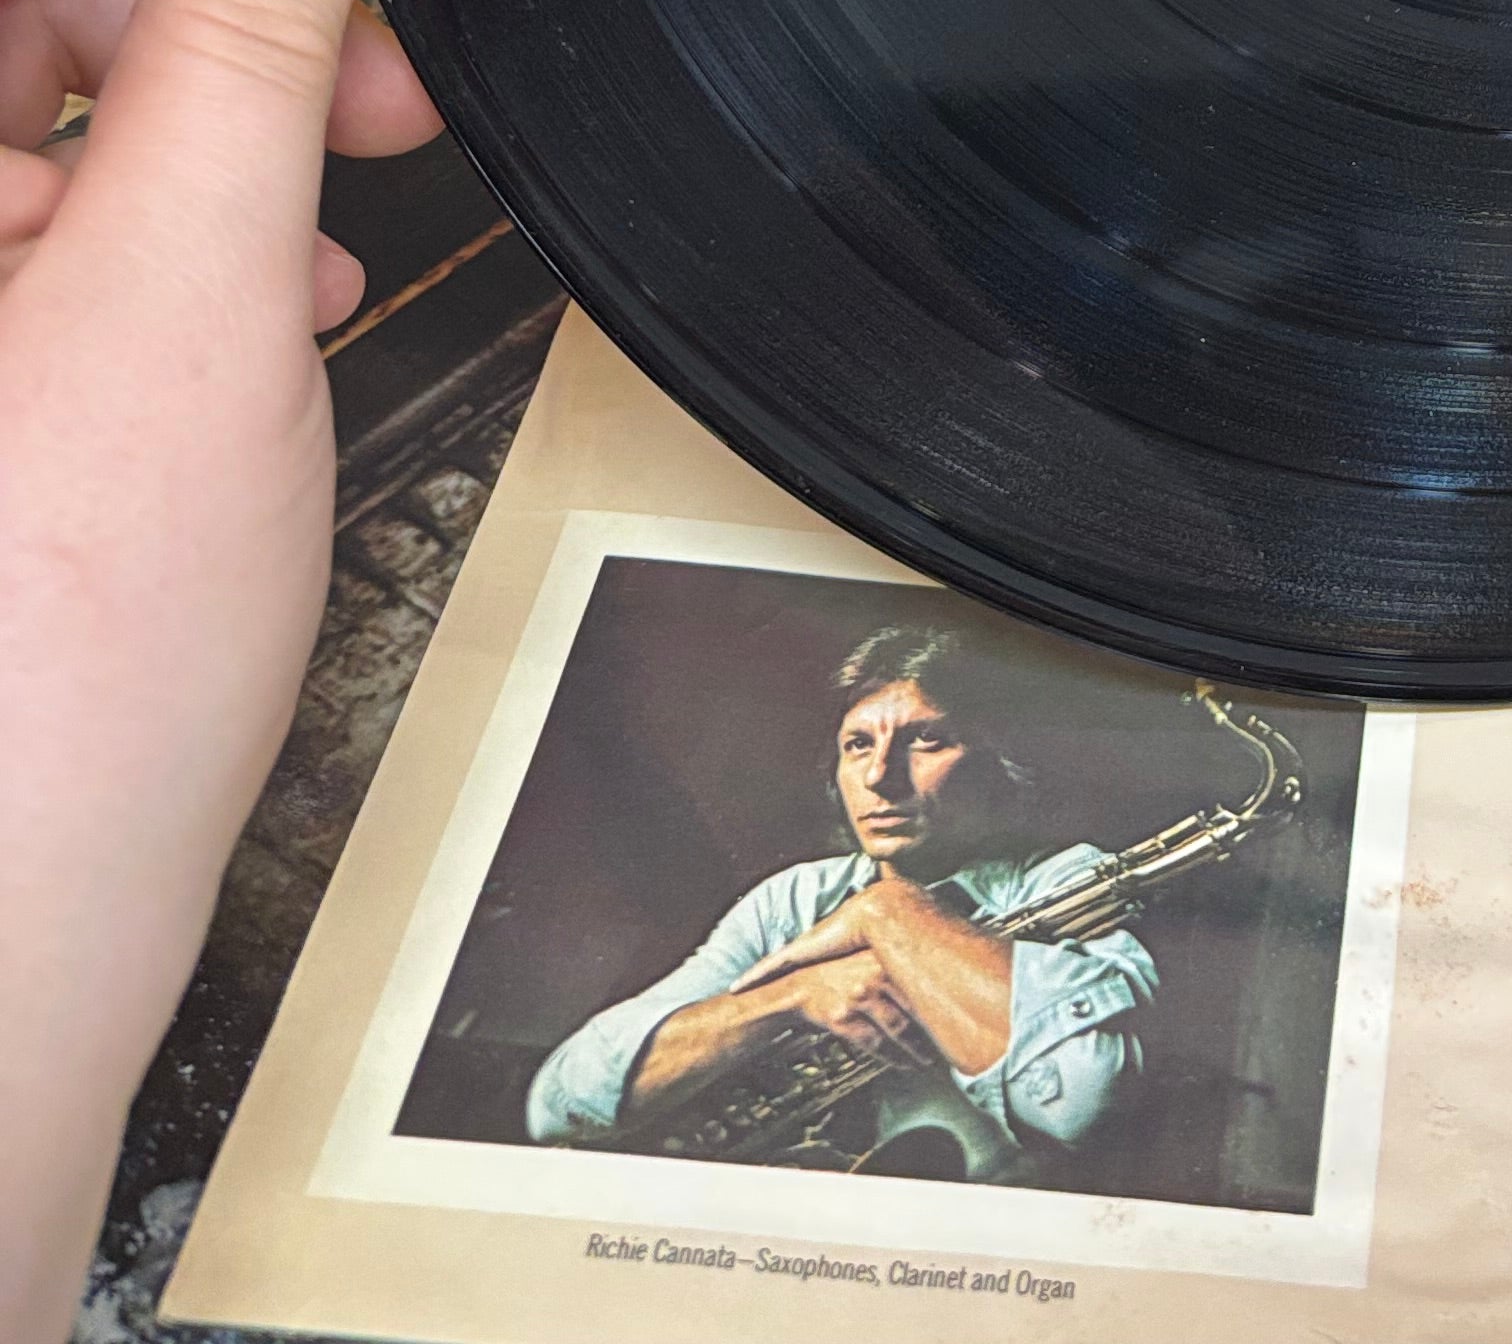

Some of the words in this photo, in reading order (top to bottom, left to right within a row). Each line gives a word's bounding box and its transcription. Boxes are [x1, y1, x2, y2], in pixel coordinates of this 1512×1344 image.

[586, 1232, 649, 1262] Richie
[888, 1260, 967, 1291] Clarinet
[971, 1269, 1010, 1294] and
[1016, 1270, 1076, 1302] Organ
